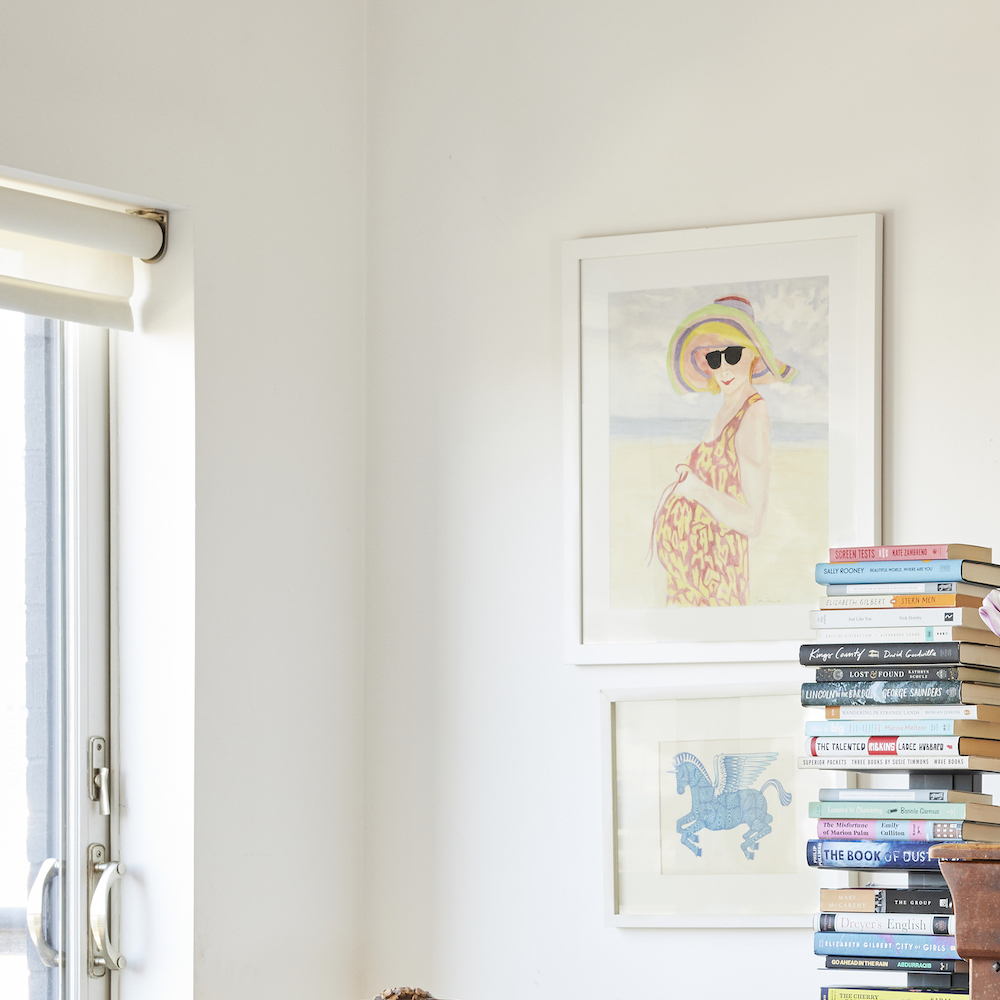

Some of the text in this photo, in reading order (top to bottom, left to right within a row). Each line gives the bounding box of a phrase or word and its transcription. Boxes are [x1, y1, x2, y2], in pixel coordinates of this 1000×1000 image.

[835, 549, 875, 559] SCREEN TESTS
[809, 647, 865, 661] Kings County
[870, 670, 877, 678] &
[883, 687, 942, 697] GEORGE SAUNDERS
[869, 742, 895, 751] RIBKINS
[824, 850, 931, 862] THE BOOK OF DUST
[841, 918, 926, 931] Dreyer's English
